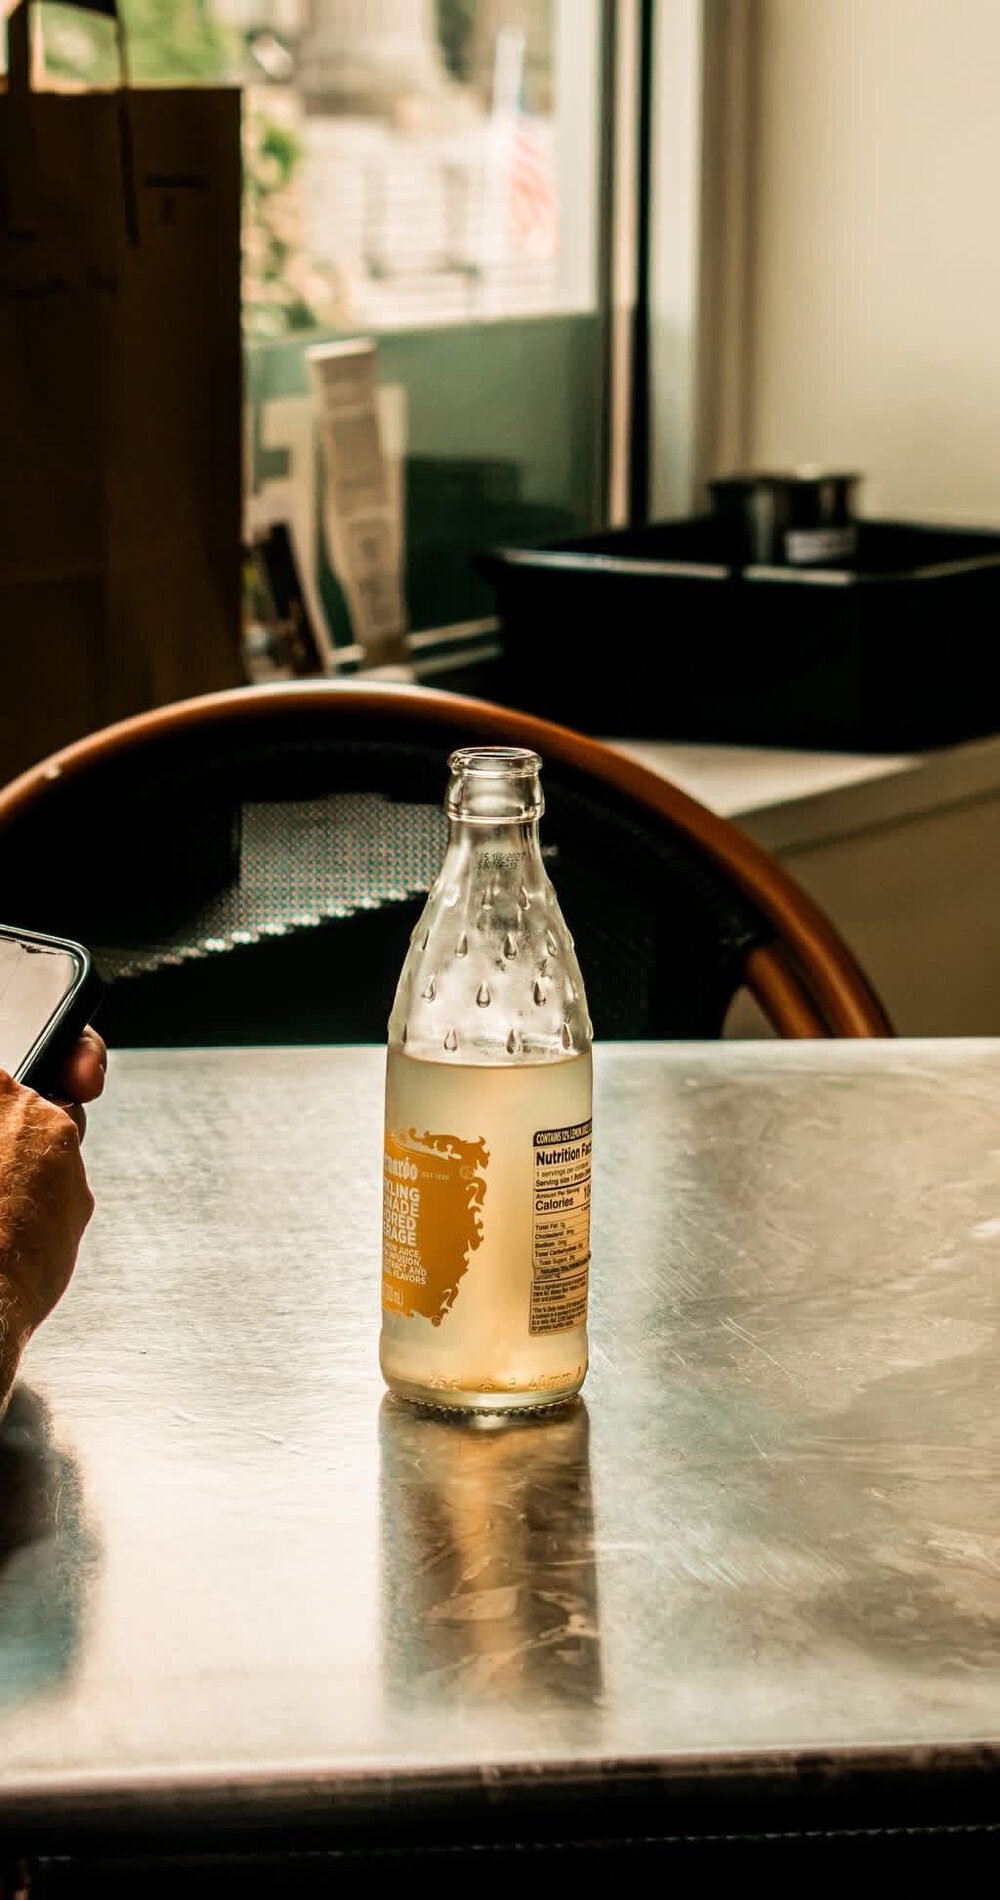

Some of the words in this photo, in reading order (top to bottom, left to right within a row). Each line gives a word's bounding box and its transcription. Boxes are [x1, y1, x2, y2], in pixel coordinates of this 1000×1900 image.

[536, 1131, 562, 1145] CONTAINS
[536, 1147, 580, 1166] Nutrition
[536, 1178, 559, 1187] Serving
[535, 1197, 574, 1211] Calories
[408, 1266, 428, 1277] AND
